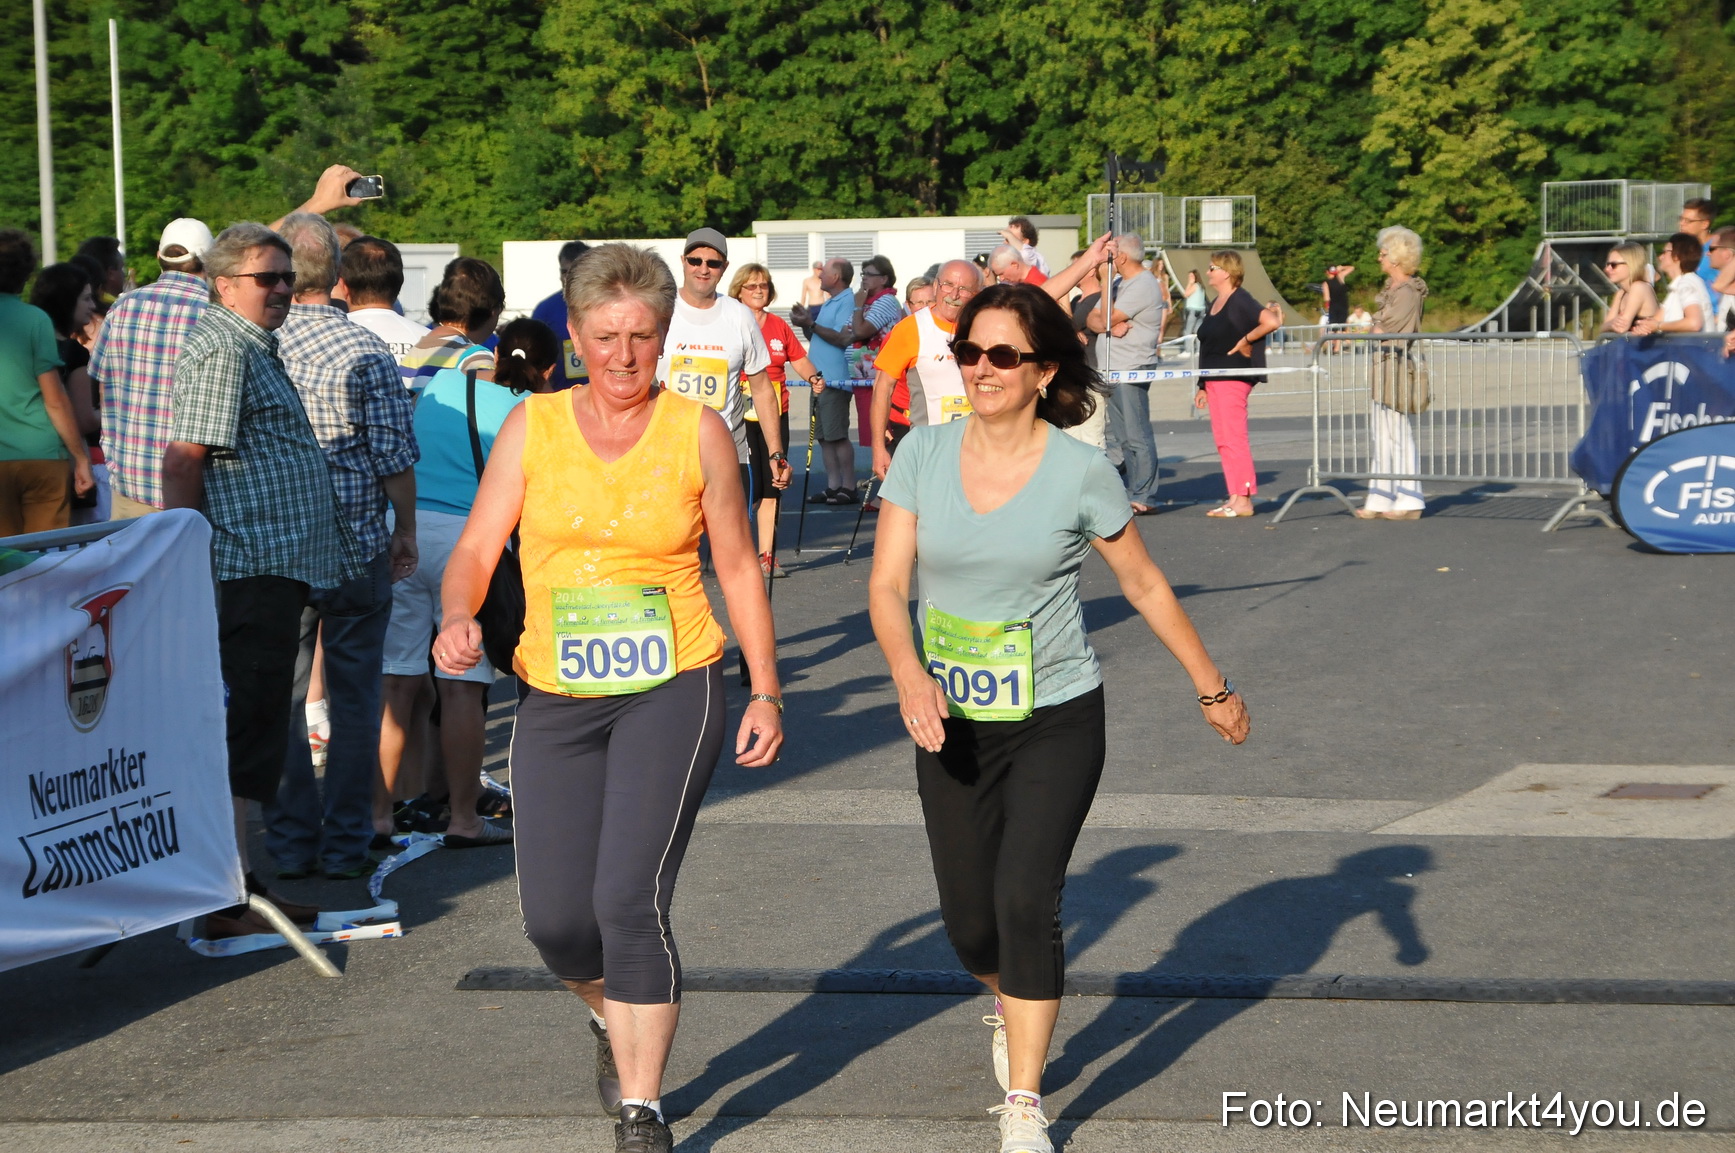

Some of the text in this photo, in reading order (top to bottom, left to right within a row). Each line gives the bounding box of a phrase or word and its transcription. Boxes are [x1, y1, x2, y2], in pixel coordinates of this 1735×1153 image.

[677, 373, 717, 396] 519
[1639, 401, 1735, 444] Fisch
[1692, 512, 1735, 526] AUT
[555, 592, 585, 604] 2014
[561, 635, 668, 680] 5090
[927, 659, 1020, 707] 5091
[28, 747, 147, 820] Neumarkter
[18, 799, 181, 899] Lammsbräu
